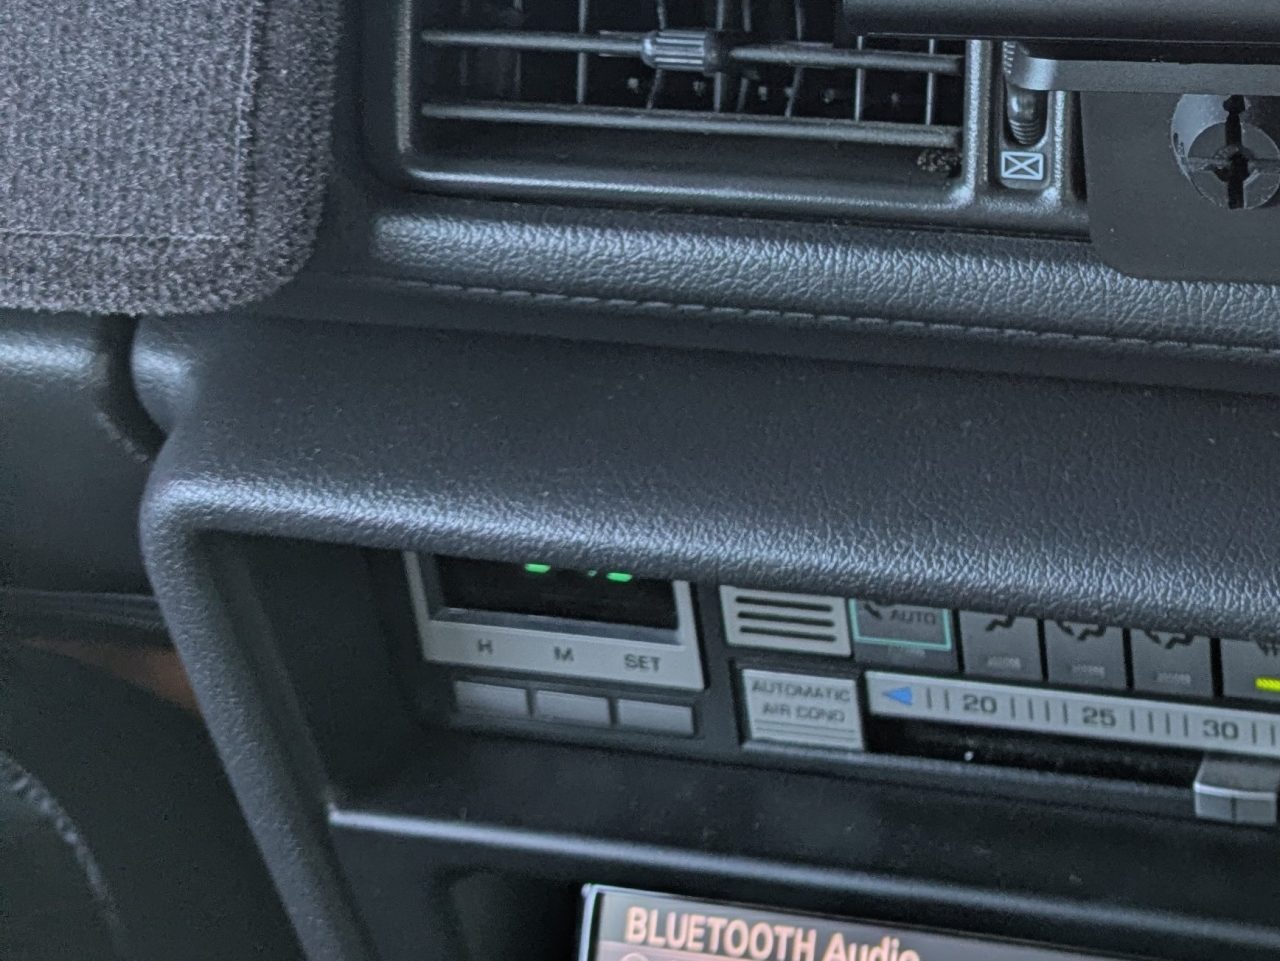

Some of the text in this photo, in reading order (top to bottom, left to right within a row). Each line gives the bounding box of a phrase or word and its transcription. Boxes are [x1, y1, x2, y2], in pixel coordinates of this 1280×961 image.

[889, 607, 938, 626] AUTO
[477, 639, 662, 672] H M SET
[752, 679, 851, 701] AUTOMATIC
[762, 703, 846, 723] AIR COND
[962, 694, 1239, 741] 20 25 30
[624, 905, 817, 961] BLUETOOTH
